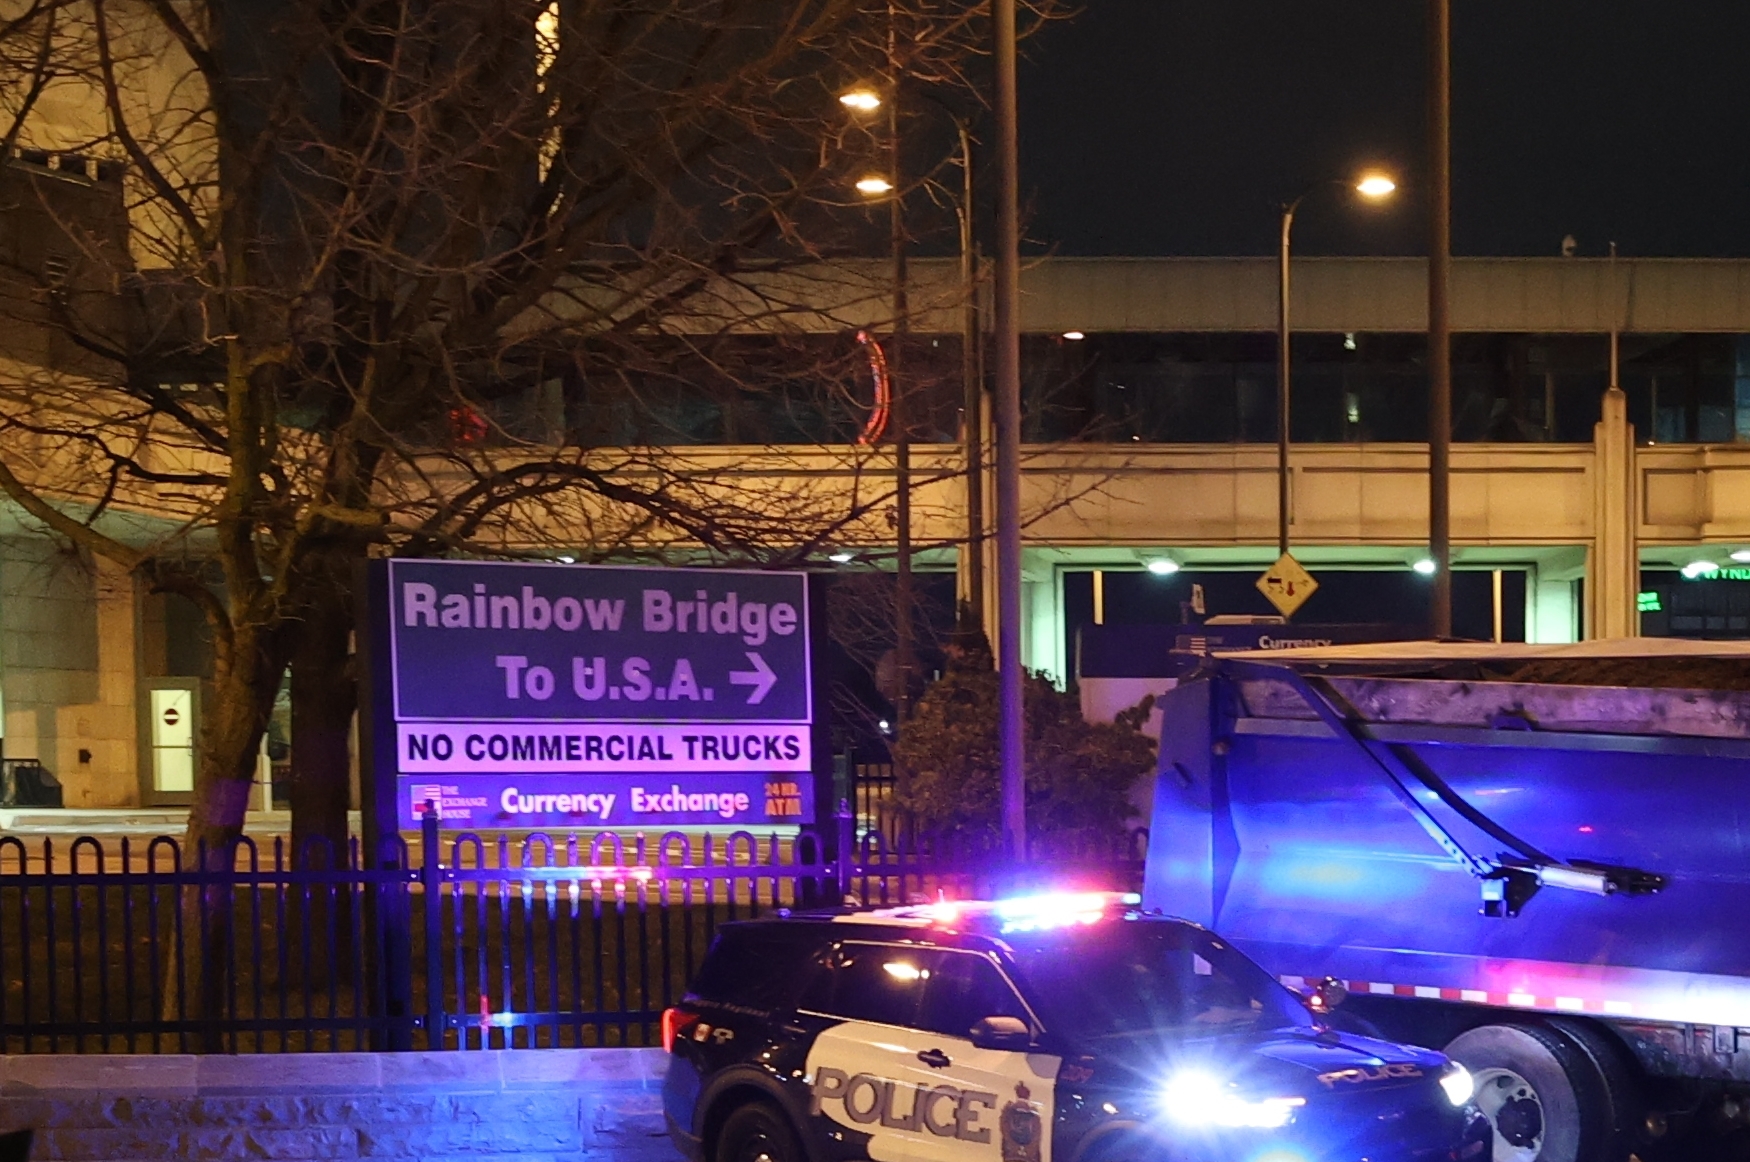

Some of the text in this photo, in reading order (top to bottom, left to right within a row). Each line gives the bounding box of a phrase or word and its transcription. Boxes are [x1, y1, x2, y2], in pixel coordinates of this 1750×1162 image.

[403, 582, 797, 646] Rainbow Bridge
[495, 655, 714, 701] To U.S.A.
[408, 734, 801, 761] NO COMMERCIAL TRUCKS
[501, 784, 749, 819] Currency Exchange
[1316, 1063, 1424, 1089] POLICE
[810, 1066, 998, 1144] POLICE
